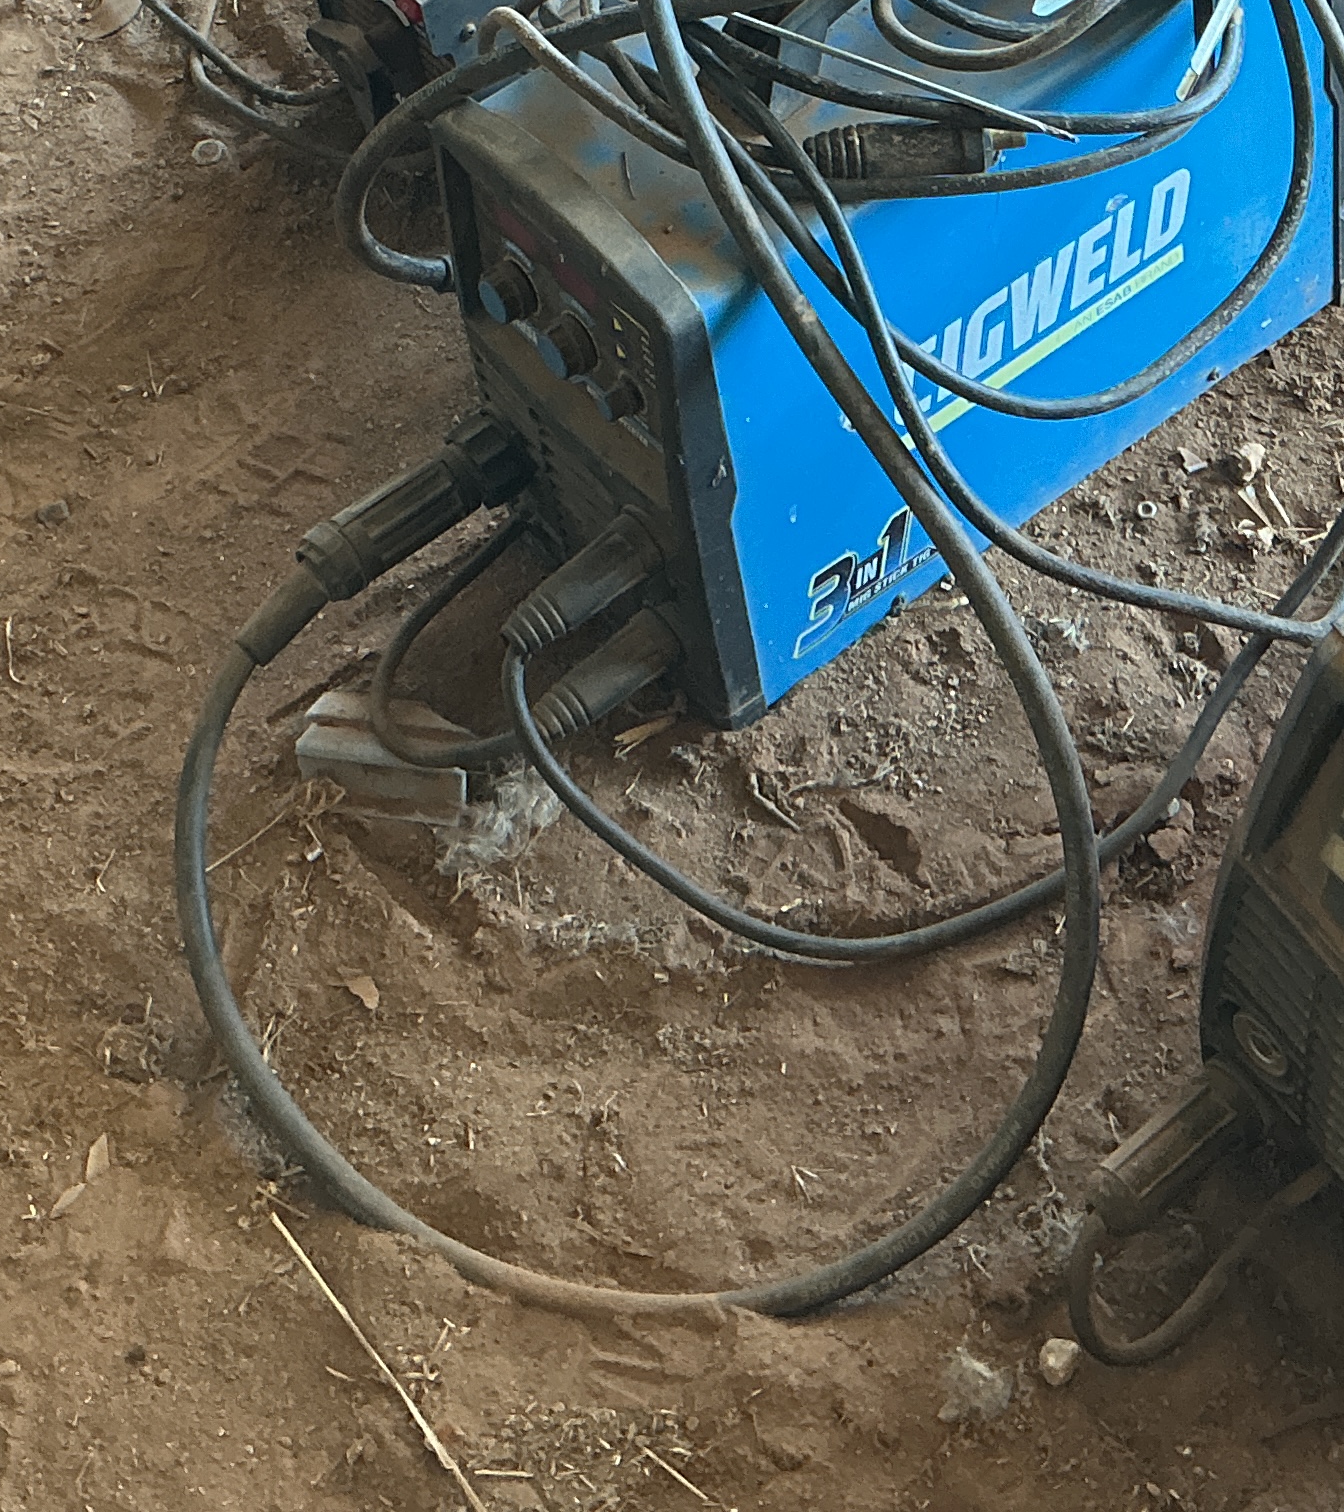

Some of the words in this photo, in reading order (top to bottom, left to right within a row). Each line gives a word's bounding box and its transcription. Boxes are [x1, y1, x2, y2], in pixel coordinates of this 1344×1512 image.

[1095, 284, 1132, 317] ESAB
[792, 551, 859, 659] 3
[856, 556, 878, 589] IN
[877, 506, 913, 580] 1
[847, 588, 872, 612] MIG
[873, 563, 909, 594] STICK
[912, 547, 932, 567] TIG
